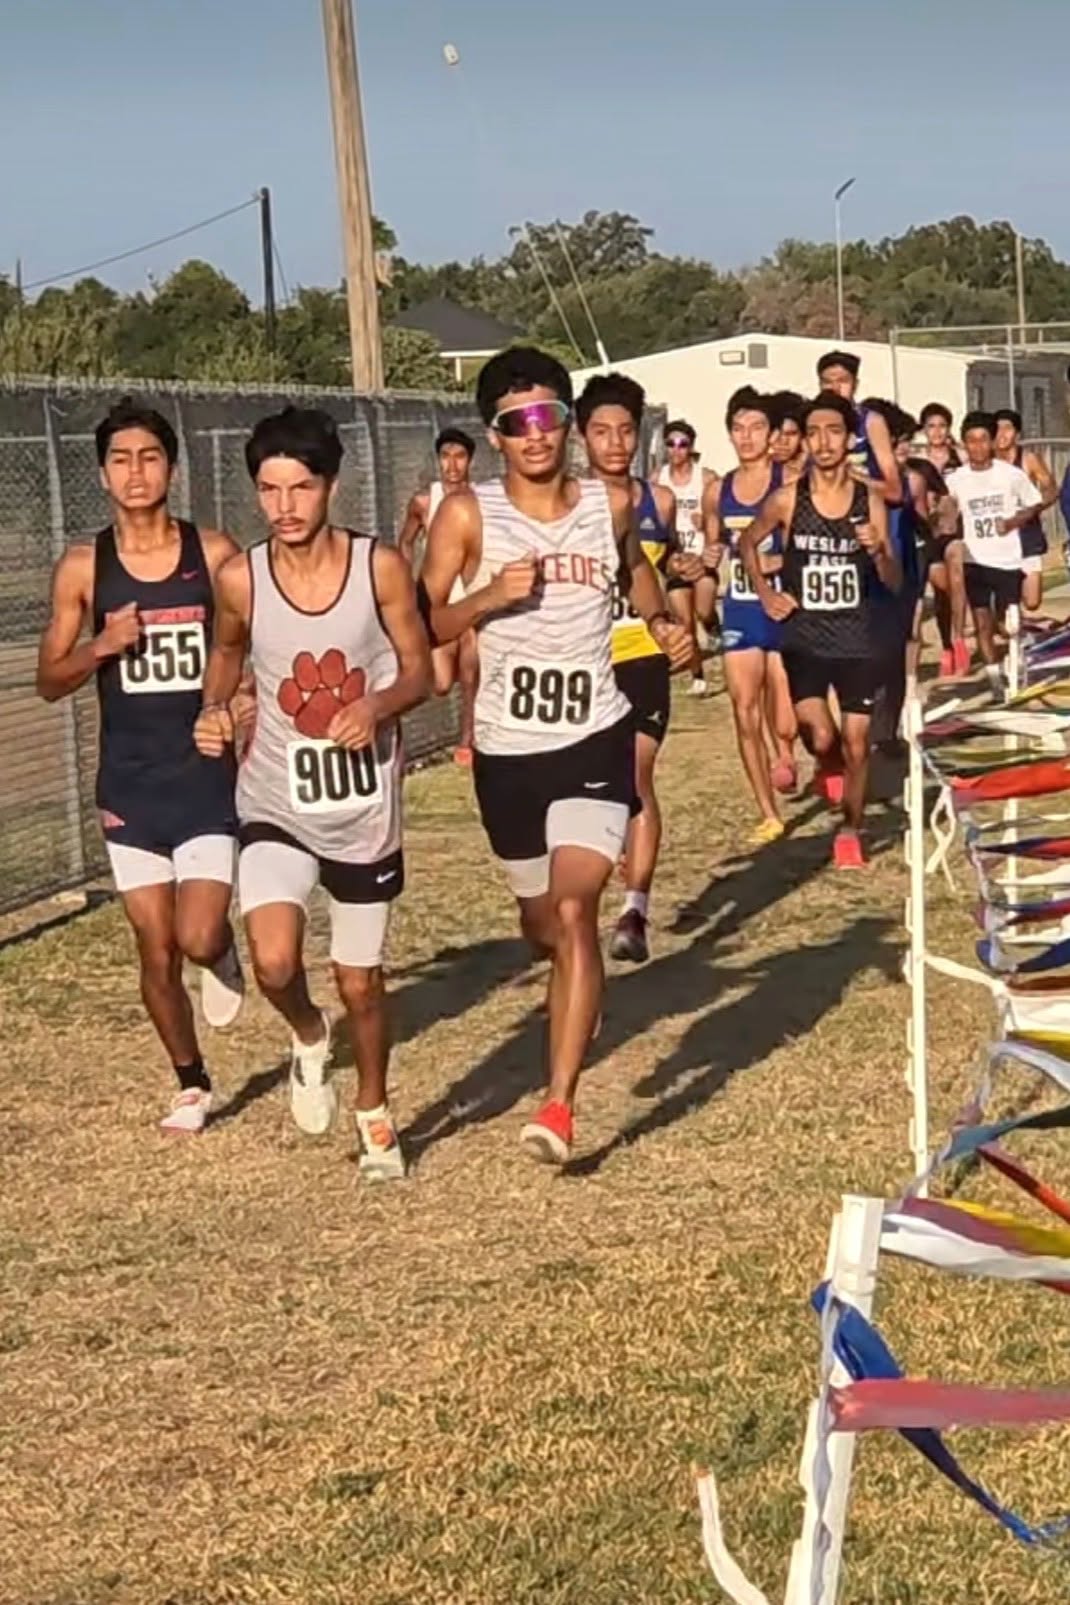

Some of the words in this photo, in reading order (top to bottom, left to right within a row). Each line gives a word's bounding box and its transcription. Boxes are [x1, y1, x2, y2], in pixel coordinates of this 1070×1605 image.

[794, 535, 860, 553] WESLAC
[541, 553, 611, 595] CEDES
[807, 571, 856, 604] 956
[509, 665, 592, 726] 899
[294, 745, 378, 805] 900
